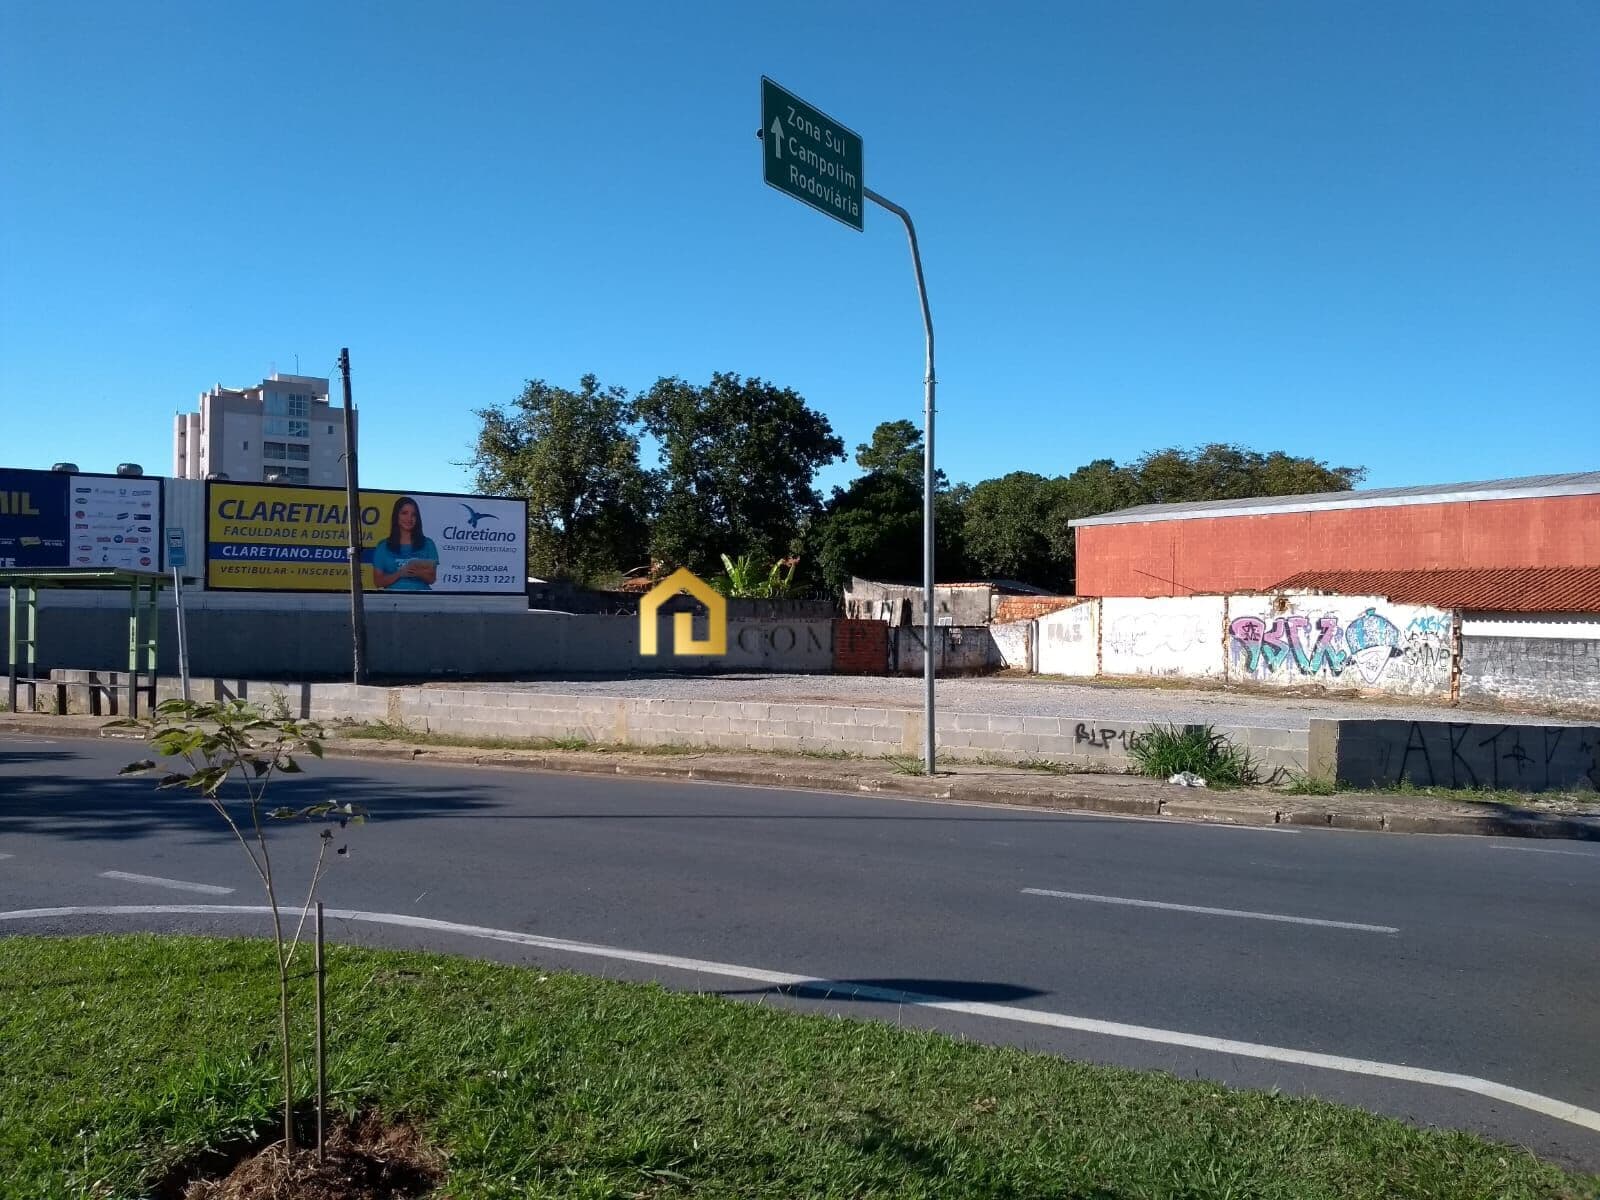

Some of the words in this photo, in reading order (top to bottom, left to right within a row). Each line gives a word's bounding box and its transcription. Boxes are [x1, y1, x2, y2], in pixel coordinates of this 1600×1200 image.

[787, 105, 821, 142] Zona
[825, 128, 846, 157] Sul
[788, 136, 856, 189] Campolim
[790, 164, 859, 217] Rodoviária
[223, 525, 297, 538] FACULDADE
[301, 529, 309, 539] A
[442, 526, 516, 542] Claretiano
[220, 566, 287, 576] VESTIBULAR
[466, 564, 508, 572] SOROCABA
[443, 574, 462, 584] (15)
[464, 575, 490, 584] 3233
[494, 575, 516, 584] 1221
